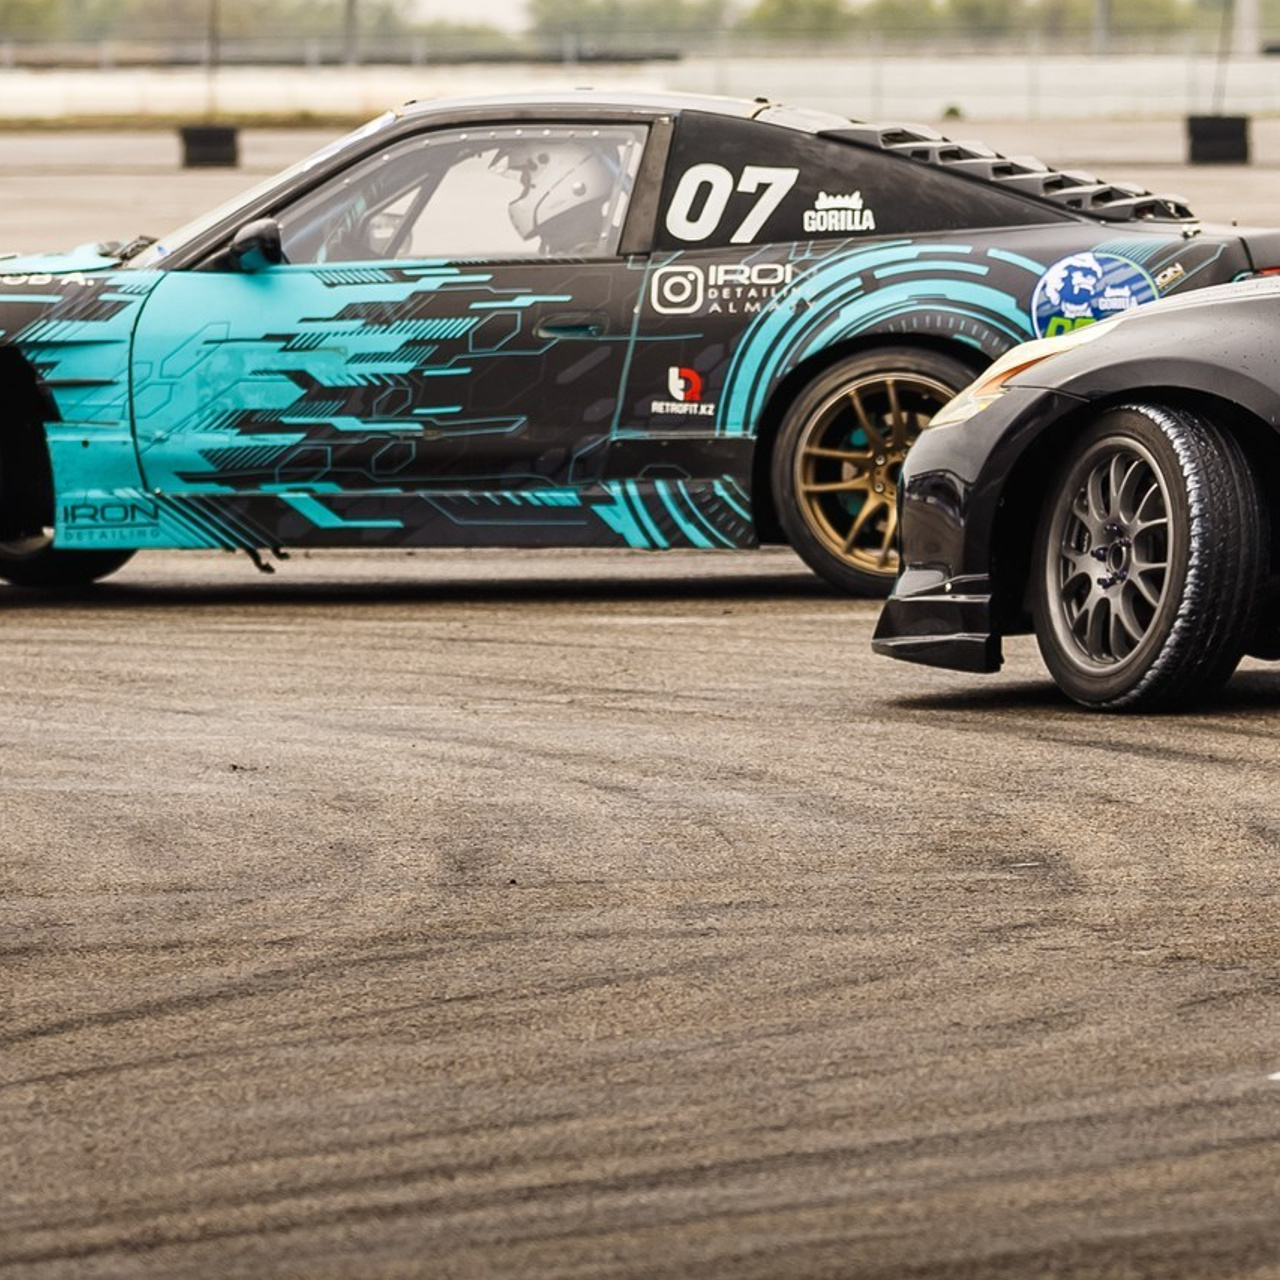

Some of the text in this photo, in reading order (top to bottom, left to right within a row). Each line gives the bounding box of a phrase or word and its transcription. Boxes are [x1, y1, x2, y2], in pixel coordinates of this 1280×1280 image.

[665, 163, 800, 243] 07
[803, 209, 876, 232] GORILLA
[708, 287, 808, 299] DETAIL
[63, 504, 159, 523] IRON
[64, 529, 160, 541] DETAILING
